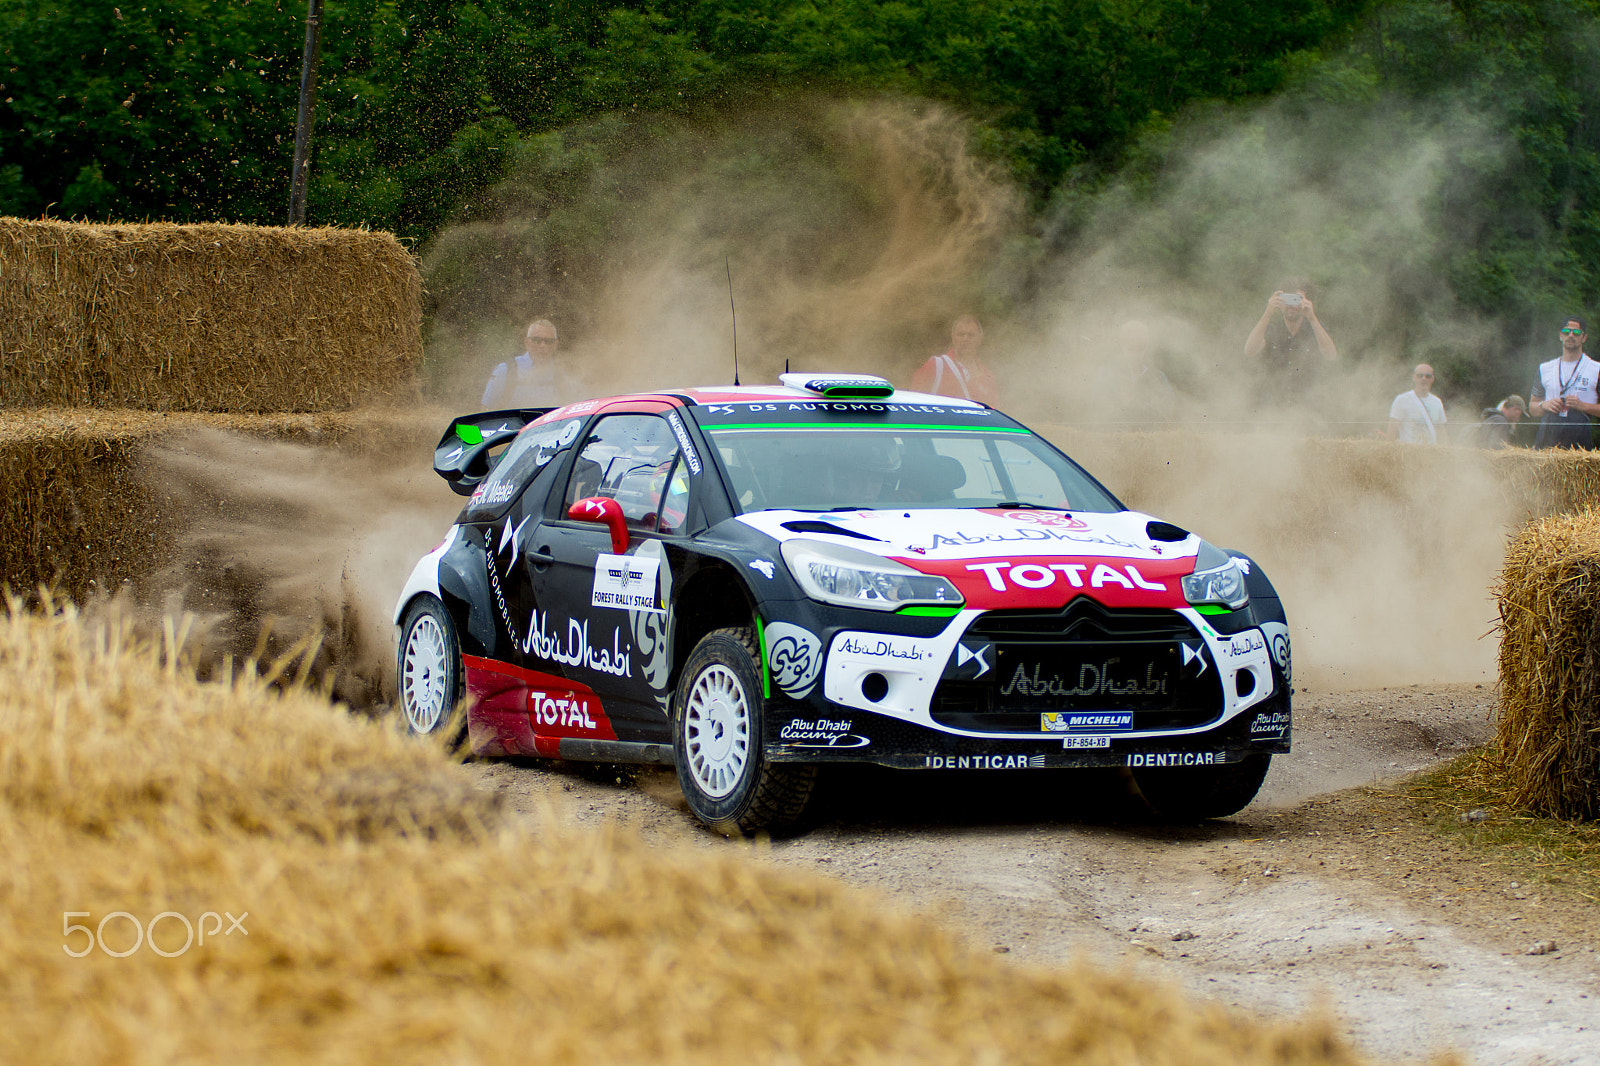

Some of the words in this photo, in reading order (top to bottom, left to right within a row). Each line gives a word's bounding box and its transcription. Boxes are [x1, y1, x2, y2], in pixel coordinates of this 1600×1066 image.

[787, 402, 946, 414] AUTOMOBILES
[965, 562, 1168, 592] TOTAL
[486, 550, 520, 651] AUTOMOBILES
[594, 591, 615, 604] FOREST
[615, 593, 634, 606] RALLY
[634, 595, 653, 608] STAGE
[531, 691, 597, 729] TOTAL
[791, 719, 815, 730] Abu
[816, 719, 853, 731] Dhabi
[1069, 715, 1131, 725] MICHELIN
[1256, 713, 1271, 724] Abu
[780, 725, 848, 746] Racing
[1067, 737, 1107, 748] BF-854-XB
[925, 754, 1028, 769] IDENTICAR
[1126, 752, 1214, 767] IDENTICAR
